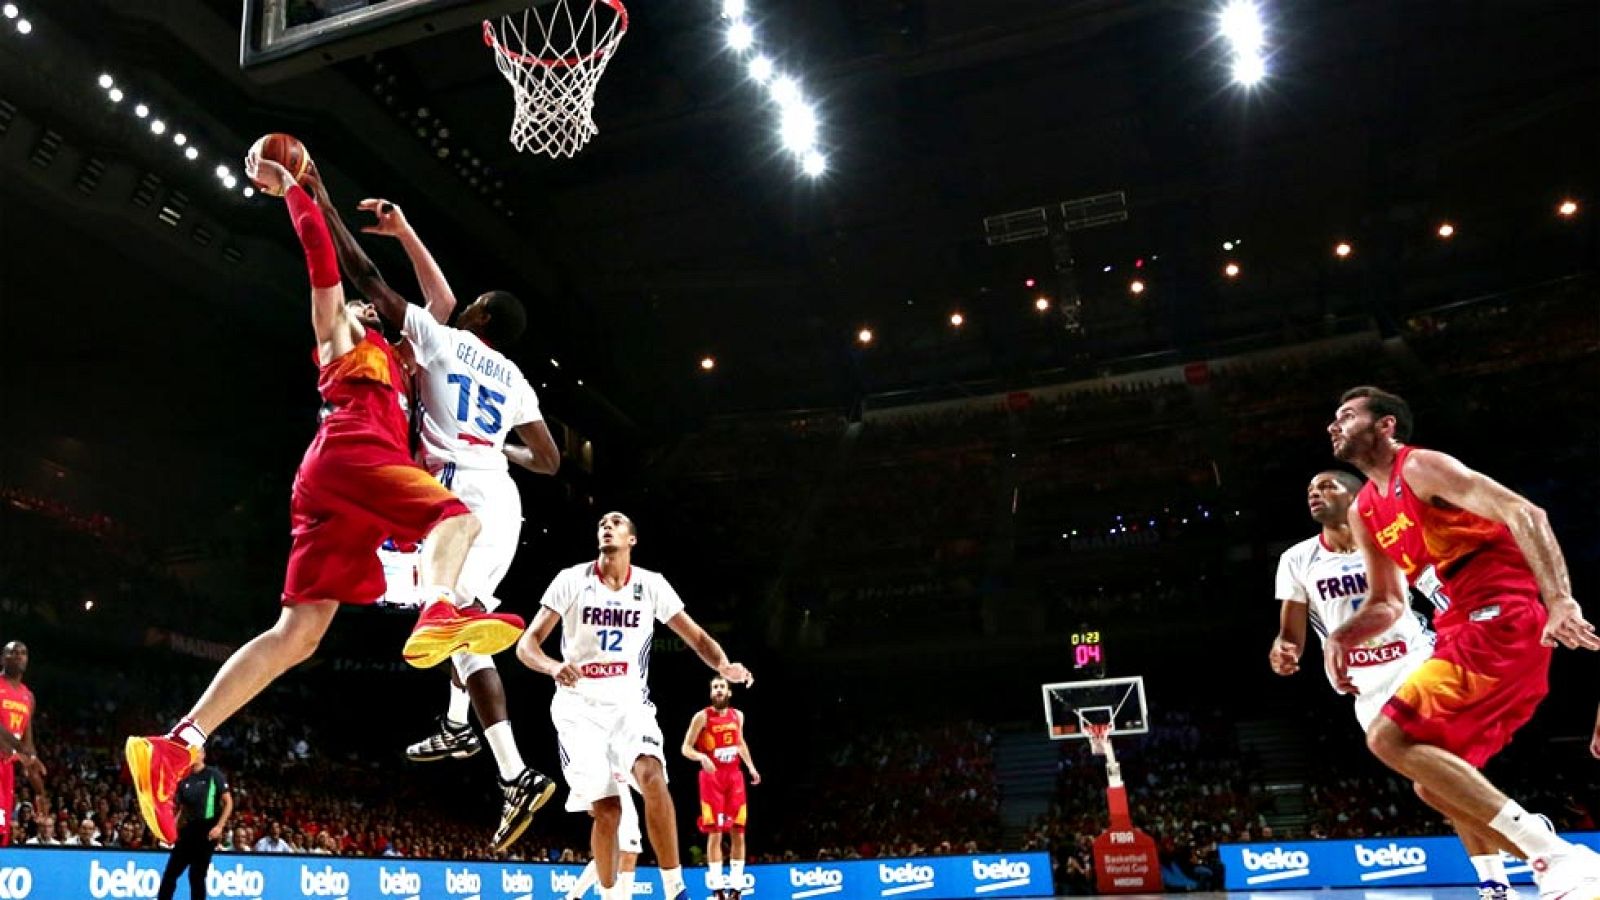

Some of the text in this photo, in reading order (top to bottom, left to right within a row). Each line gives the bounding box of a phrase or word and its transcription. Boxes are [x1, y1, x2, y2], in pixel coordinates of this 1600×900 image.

[447, 373, 506, 434] 15
[1316, 572, 1368, 601] FRAN
[582, 606, 641, 628] FRANCE
[596, 629, 624, 652] 12
[1075, 644, 1100, 665] 04
[1109, 832, 1135, 844] FIBA
[1242, 849, 1309, 869] beko
[1356, 844, 1425, 866] beko
[89, 859, 161, 898] beko
[206, 862, 264, 896] beko
[301, 864, 349, 895] beko
[379, 866, 421, 894] beko
[446, 867, 480, 894] beko
[502, 869, 533, 892] beko
[790, 867, 843, 887] beko
[879, 863, 934, 882] beko
[972, 858, 1030, 880] beko
